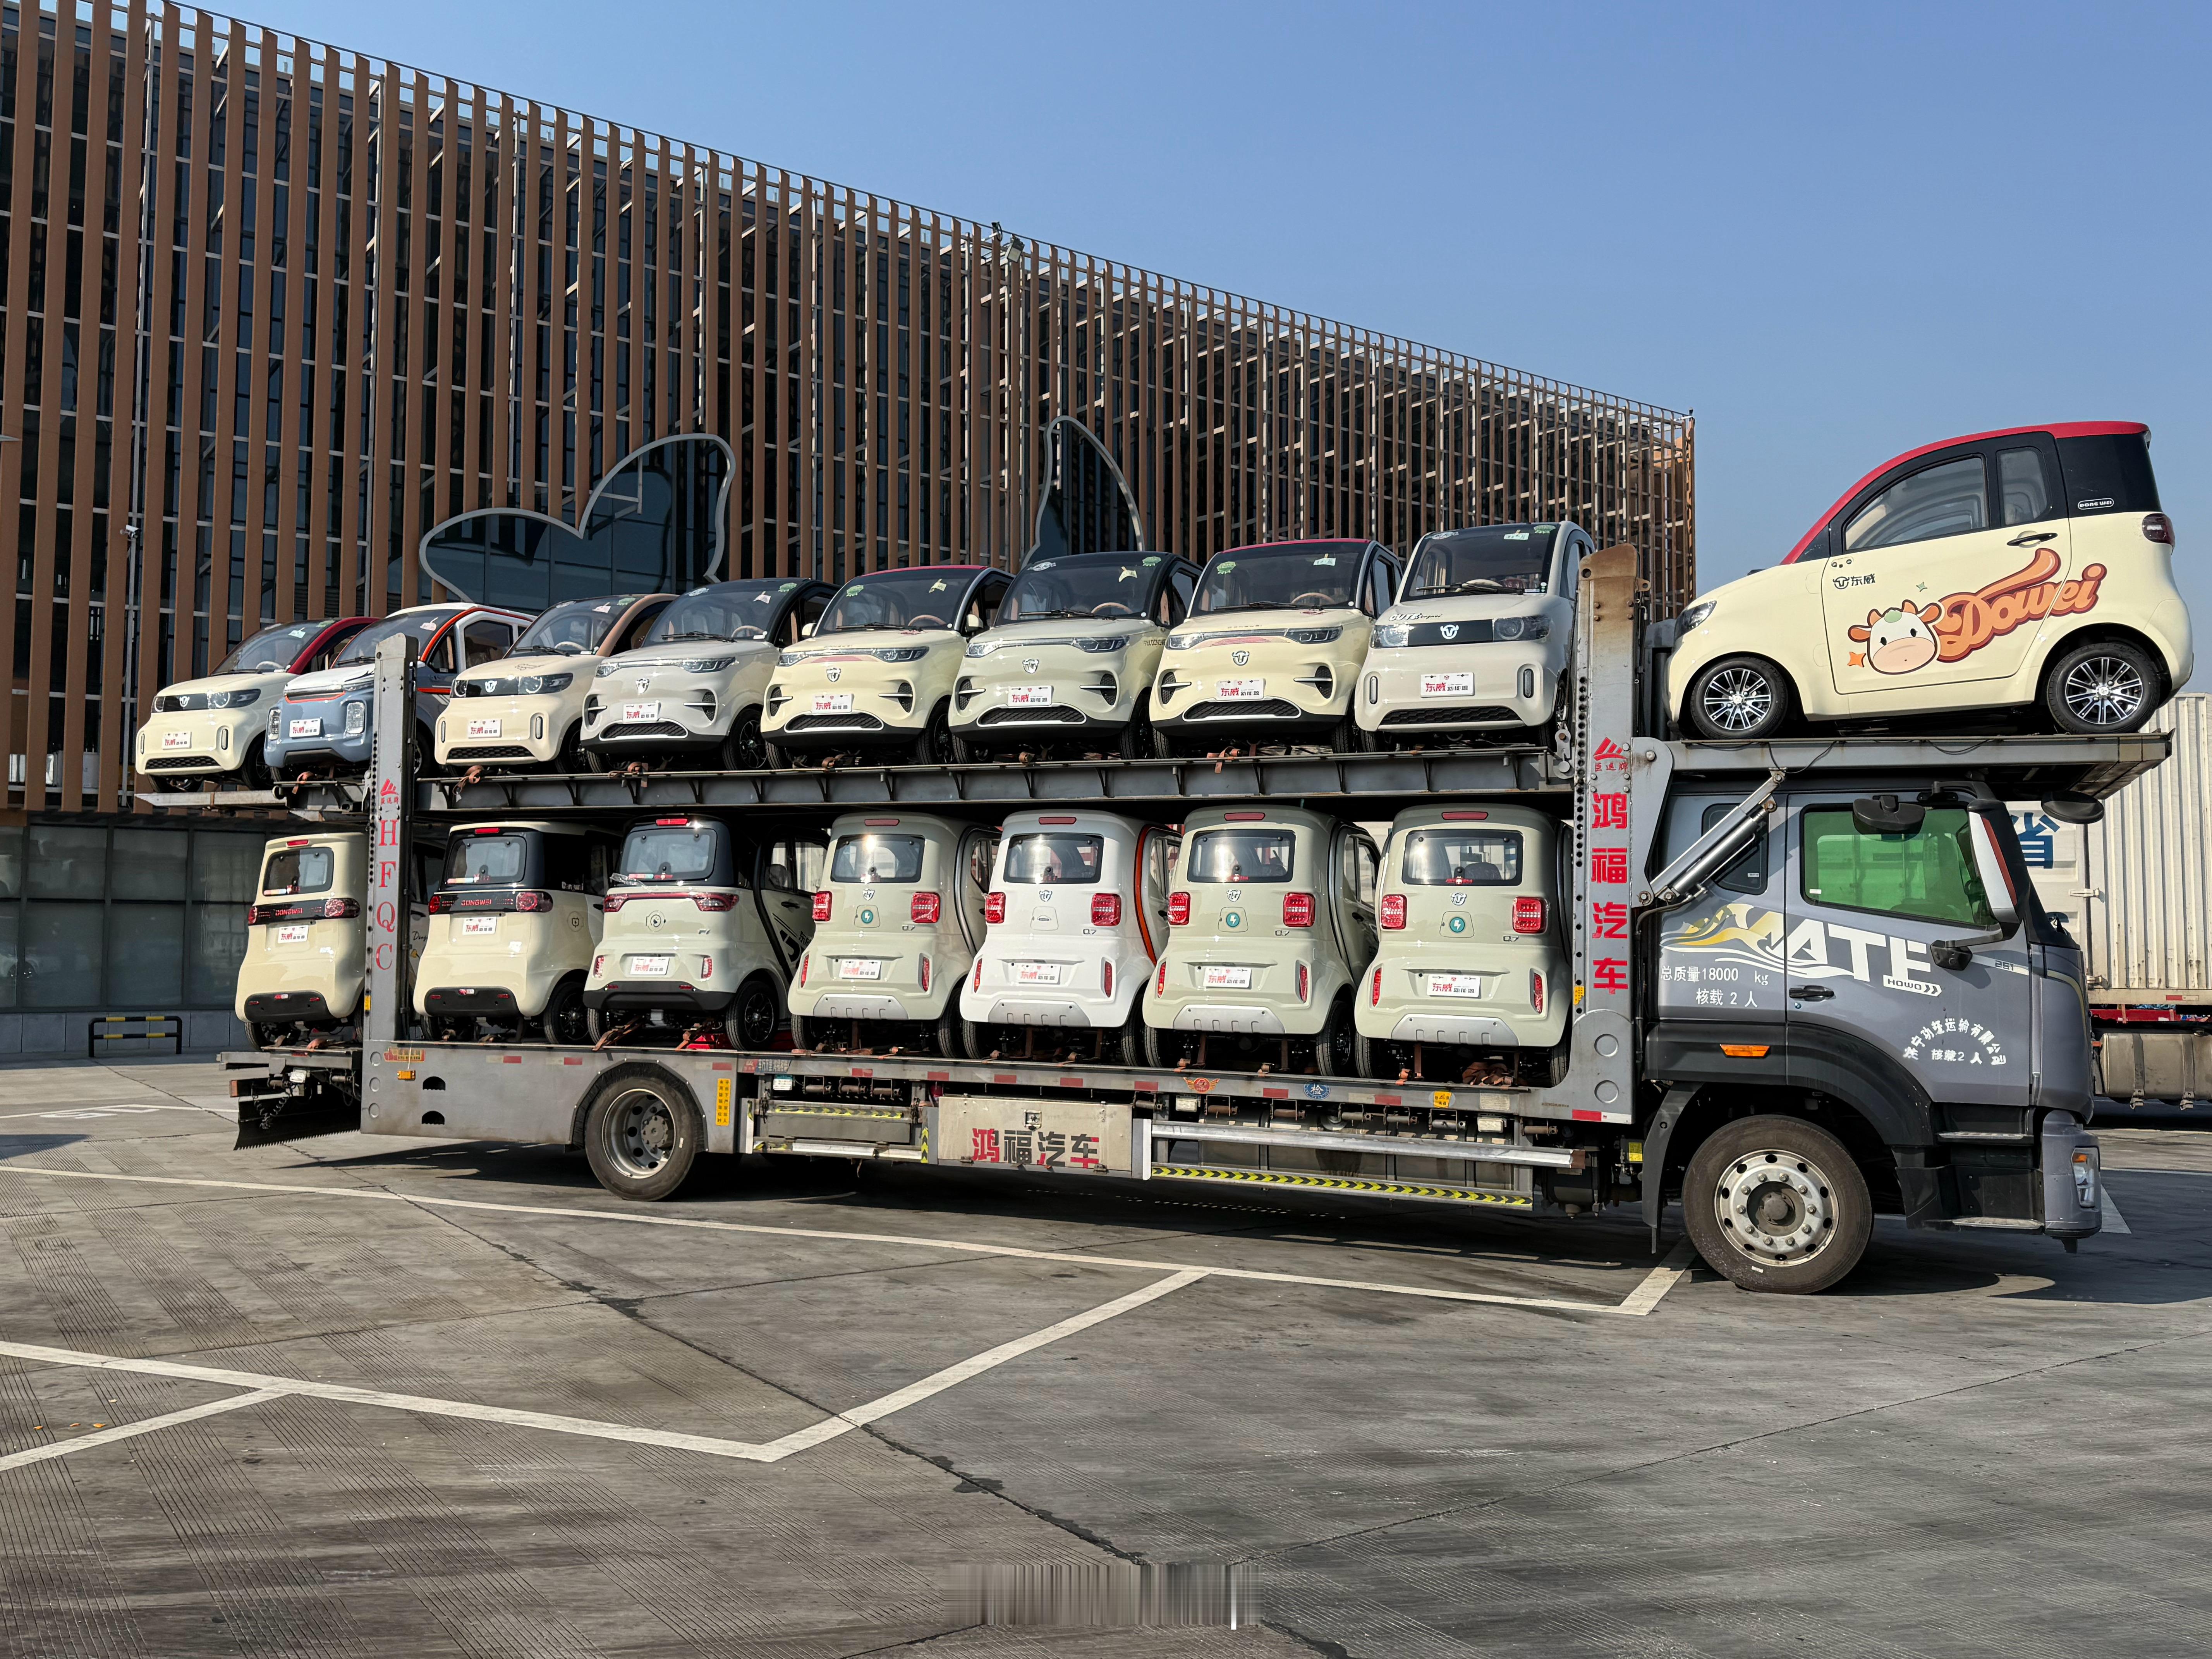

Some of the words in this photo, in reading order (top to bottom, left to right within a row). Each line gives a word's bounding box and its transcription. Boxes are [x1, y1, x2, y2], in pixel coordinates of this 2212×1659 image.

[1850, 573, 1875, 586] 东威
[1936, 548, 2107, 663] Dowei
[1592, 792, 1628, 994] 鸿福汽车
[1995, 960, 2014, 971] 251
[1432, 982, 1453, 992] 东威
[1888, 979, 1922, 990] HOWO
[1310, 1083, 1324, 1095] 检
[972, 1128, 1100, 1168] 鸿福汽车
